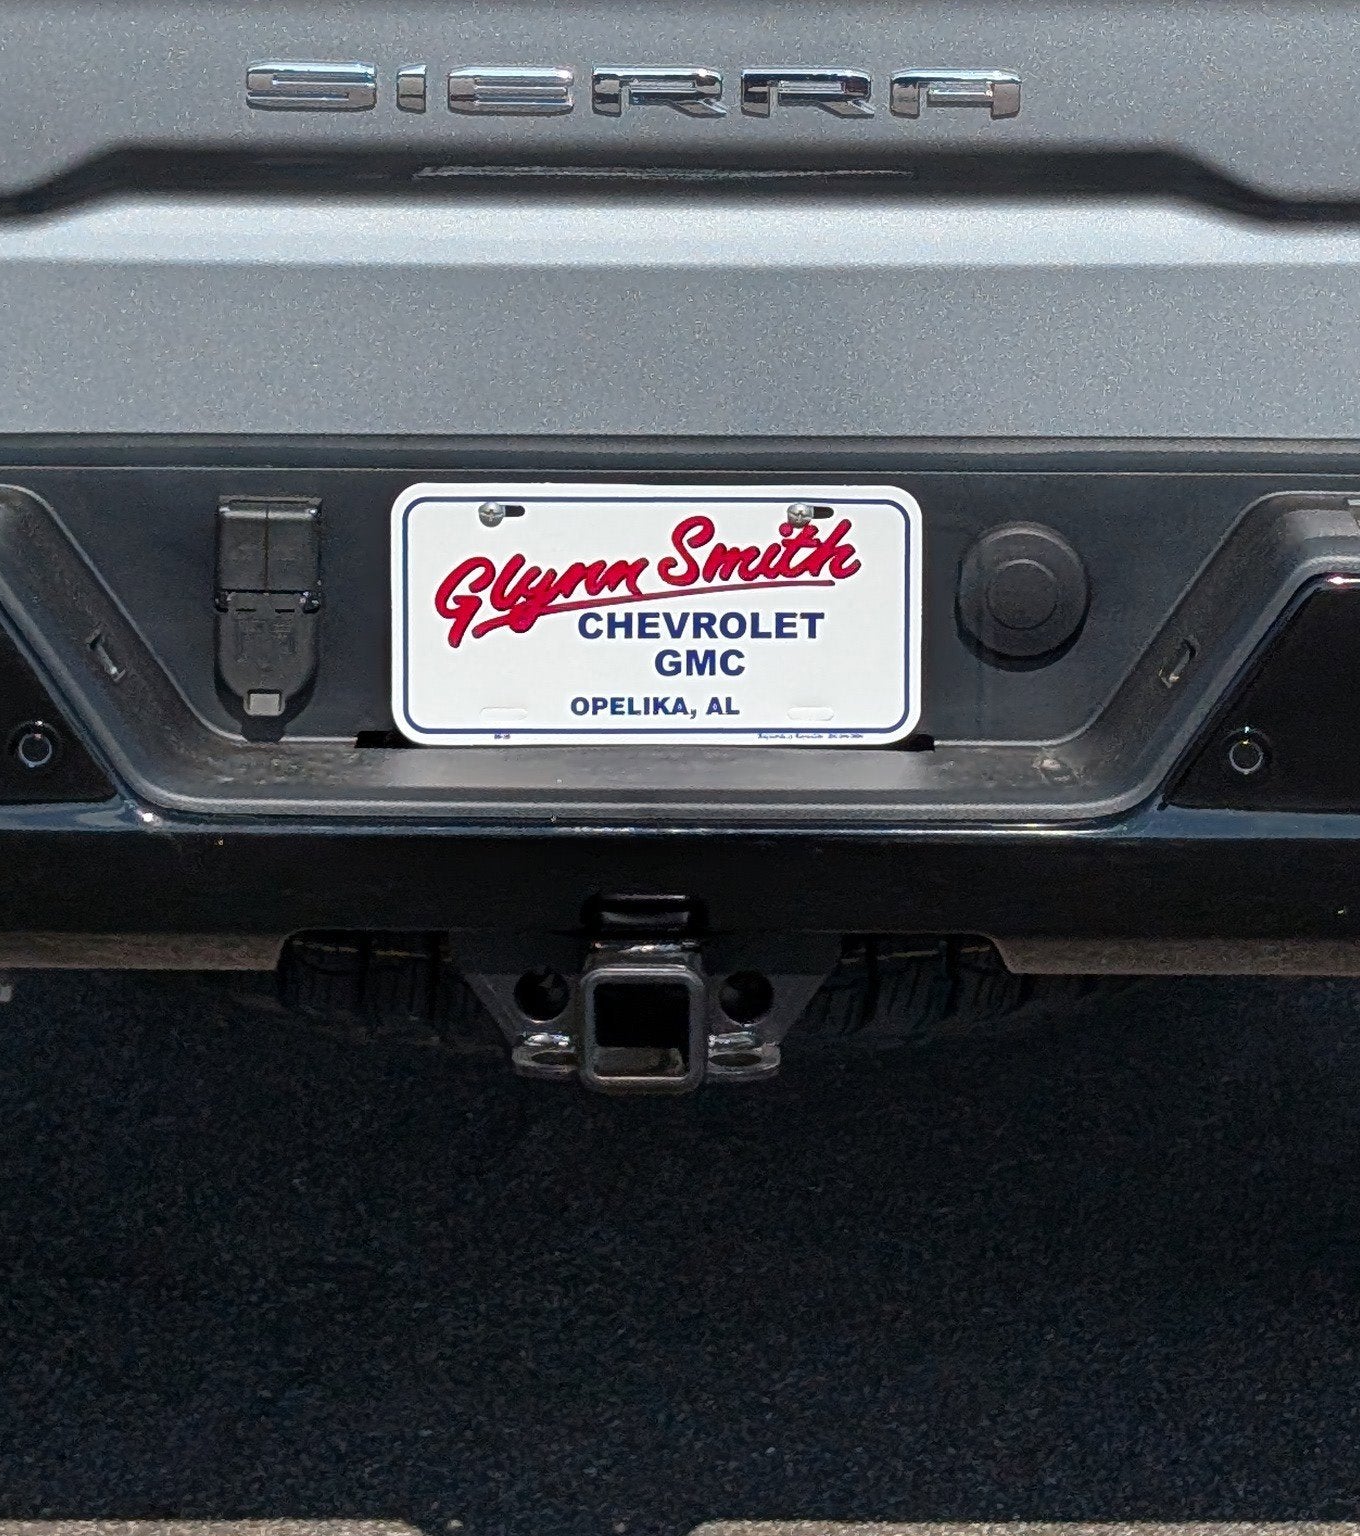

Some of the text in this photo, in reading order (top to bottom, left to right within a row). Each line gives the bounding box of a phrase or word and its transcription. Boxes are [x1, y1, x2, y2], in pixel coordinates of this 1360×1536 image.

[244, 59, 1023, 118] SIERRA
[435, 516, 862, 648] Glynn Smith
[578, 612, 825, 639] CHEVROLET
[655, 649, 746, 676] GMC
[570, 697, 740, 719] OPELIKA, AL
